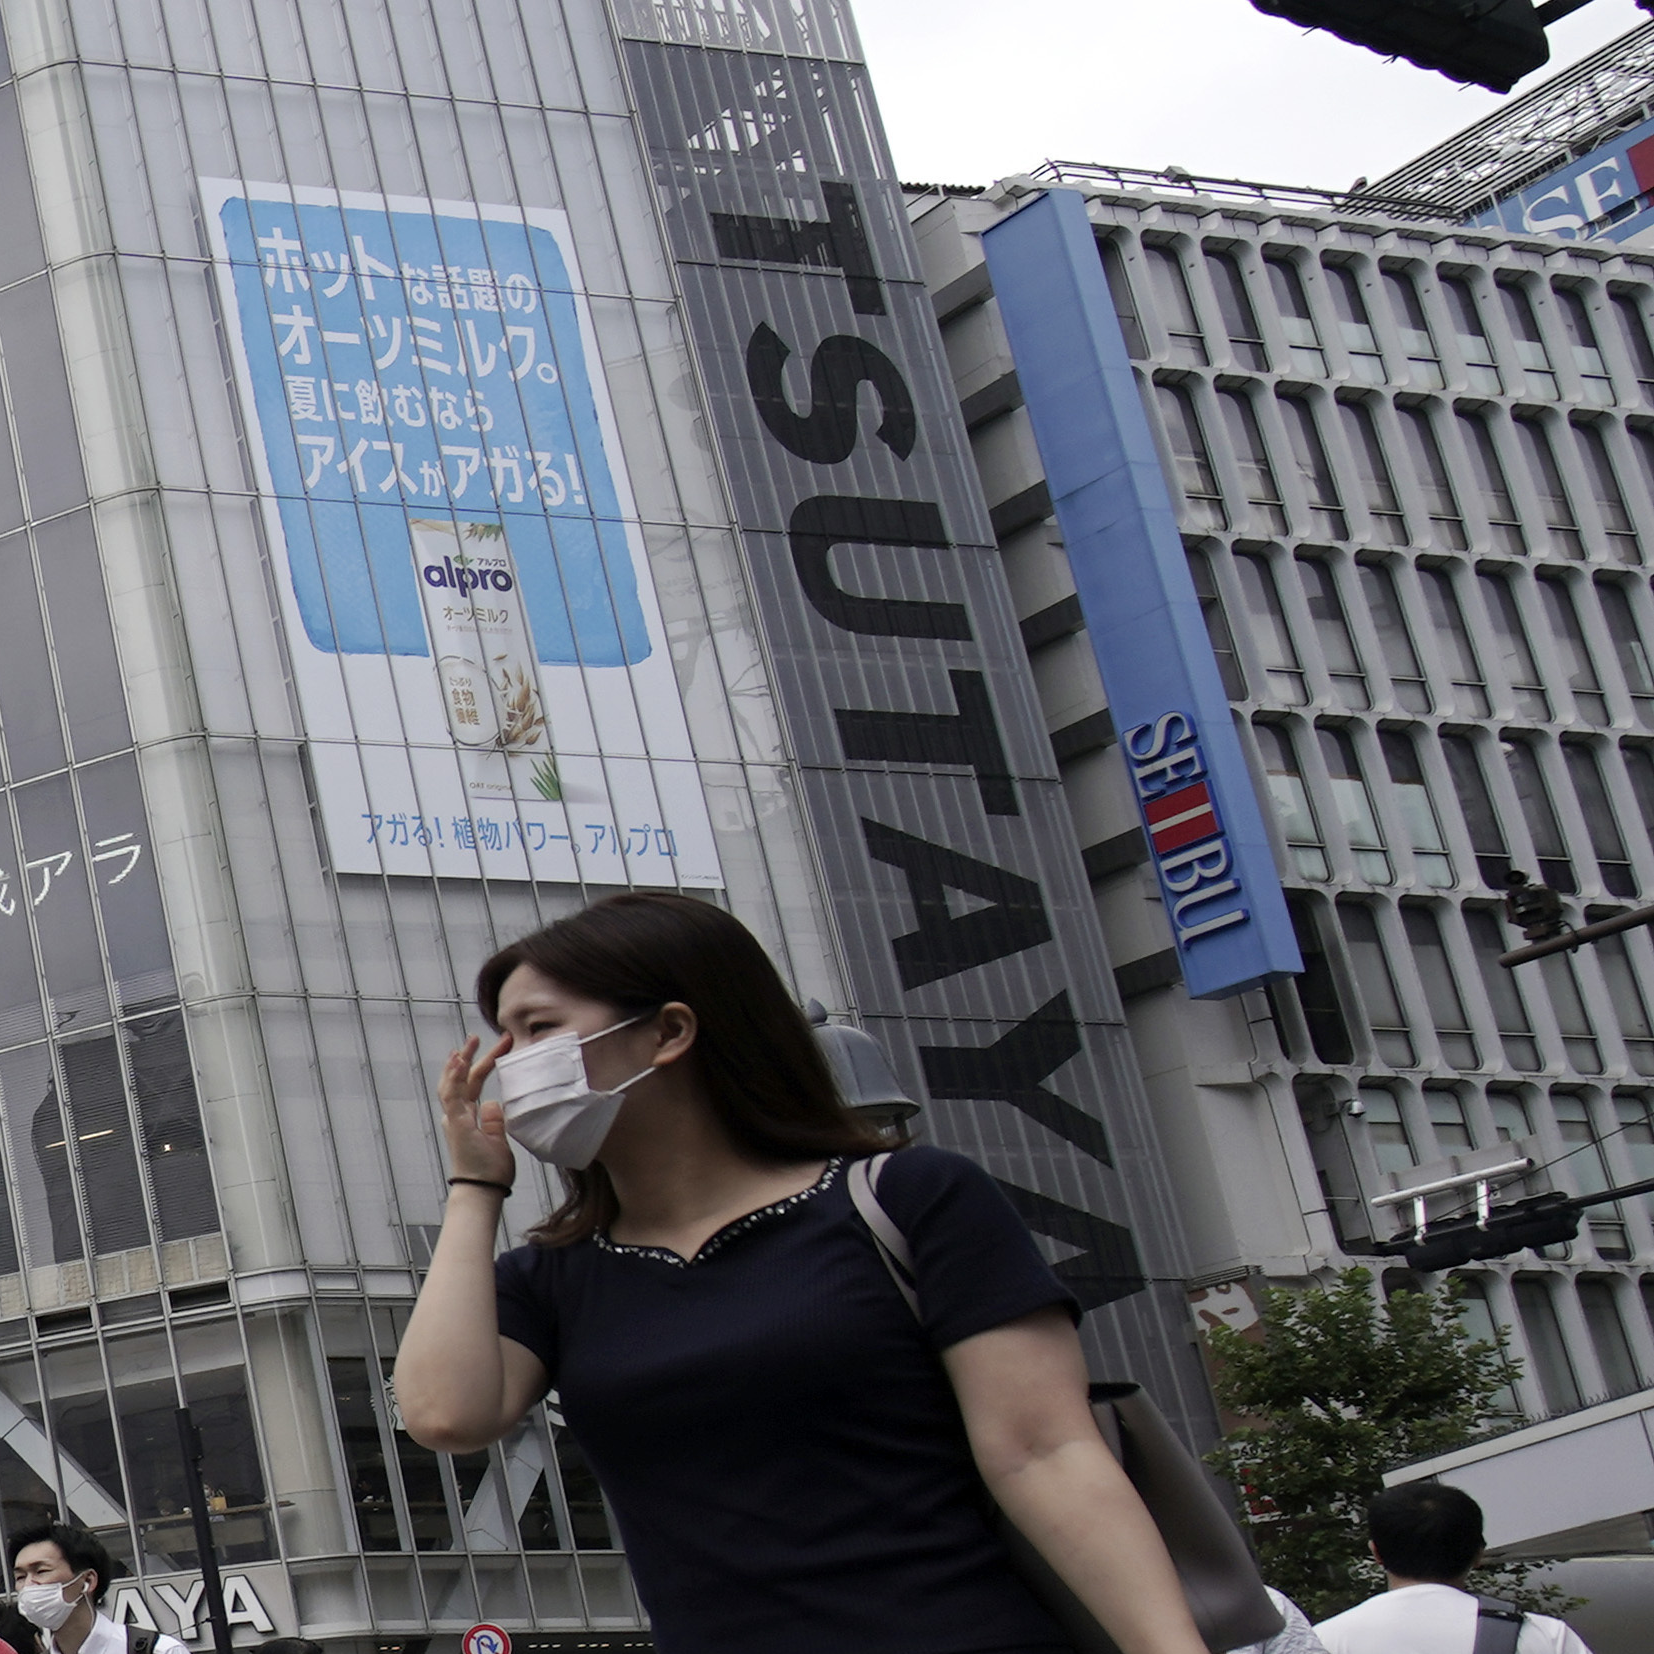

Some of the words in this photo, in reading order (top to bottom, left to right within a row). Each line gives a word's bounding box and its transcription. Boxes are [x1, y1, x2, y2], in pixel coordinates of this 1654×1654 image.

[257, 226, 539, 315] ホットな話題の
[273, 306, 558, 386] オーツミルク。
[286, 374, 494, 434] 夏に飲むなら
[424, 554, 514, 598] alpro
[443, 605, 510, 625] オーツミルク
[1122, 710, 1251, 951] SEIBU
